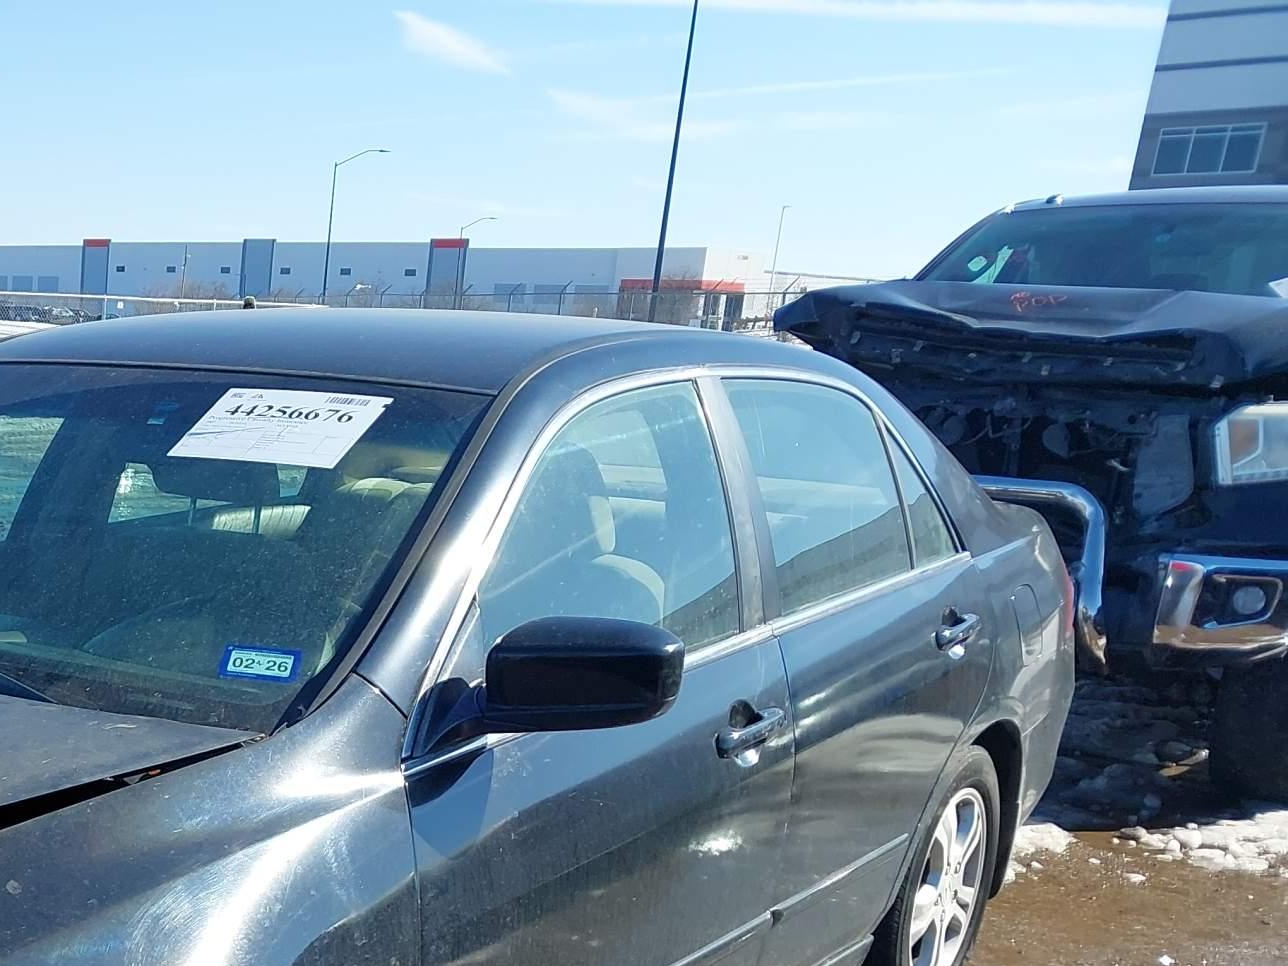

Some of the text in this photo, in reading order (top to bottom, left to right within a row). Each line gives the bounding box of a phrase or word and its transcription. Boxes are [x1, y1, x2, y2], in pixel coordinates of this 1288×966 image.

[224, 403, 360, 424] 44256676
[232, 656, 290, 673] 02 26
